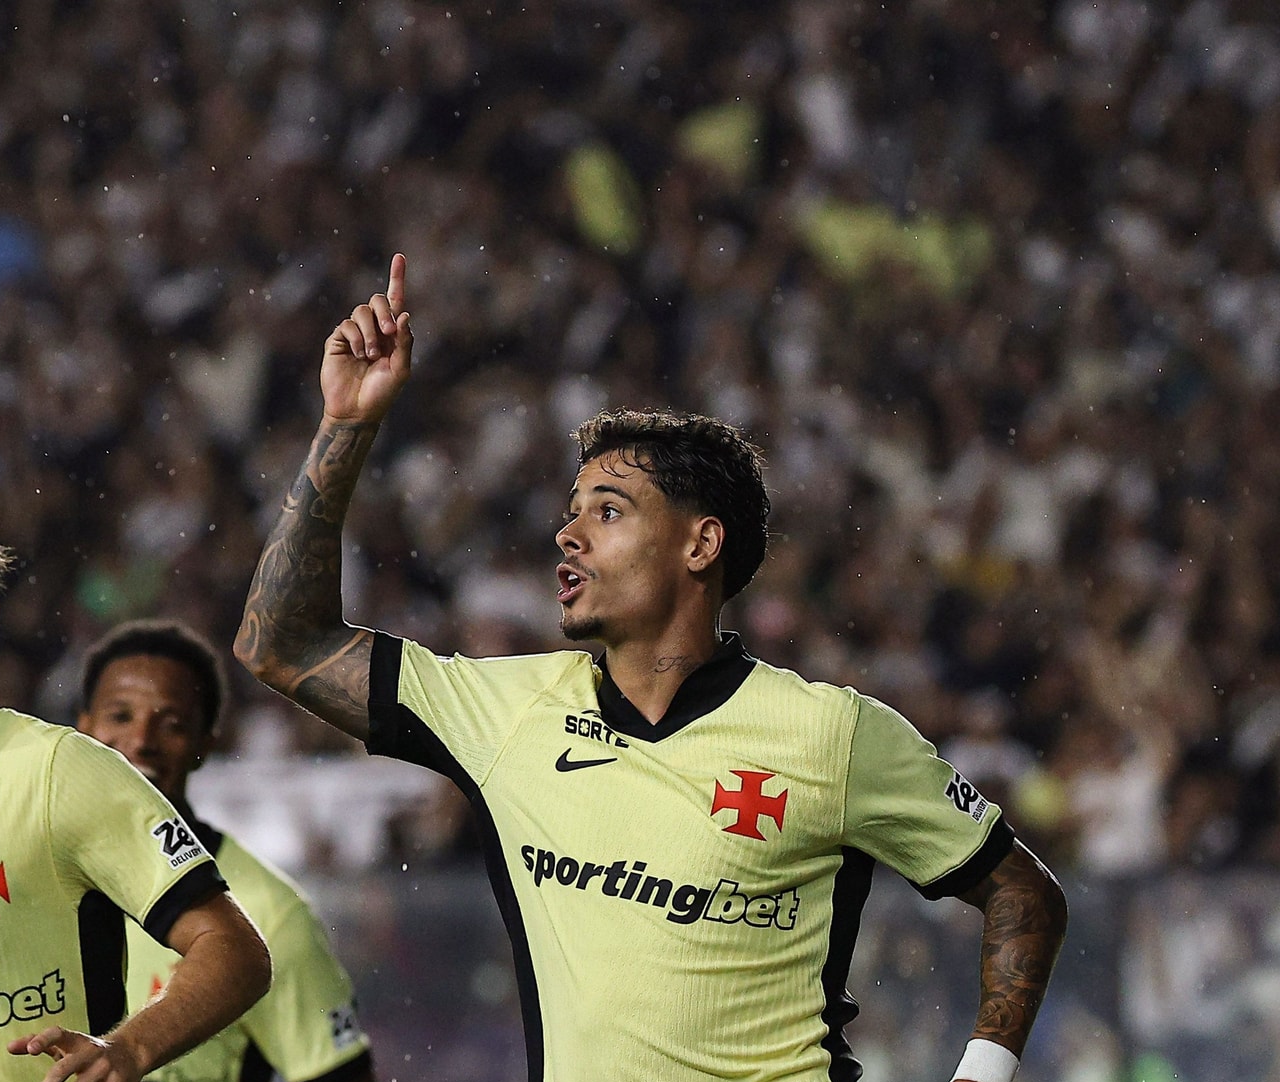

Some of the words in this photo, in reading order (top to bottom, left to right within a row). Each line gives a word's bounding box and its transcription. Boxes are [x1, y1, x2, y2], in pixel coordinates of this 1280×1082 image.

[945, 772, 979, 813] Zé
[153, 818, 195, 856] Zé
[521, 844, 800, 930] sportingbet
